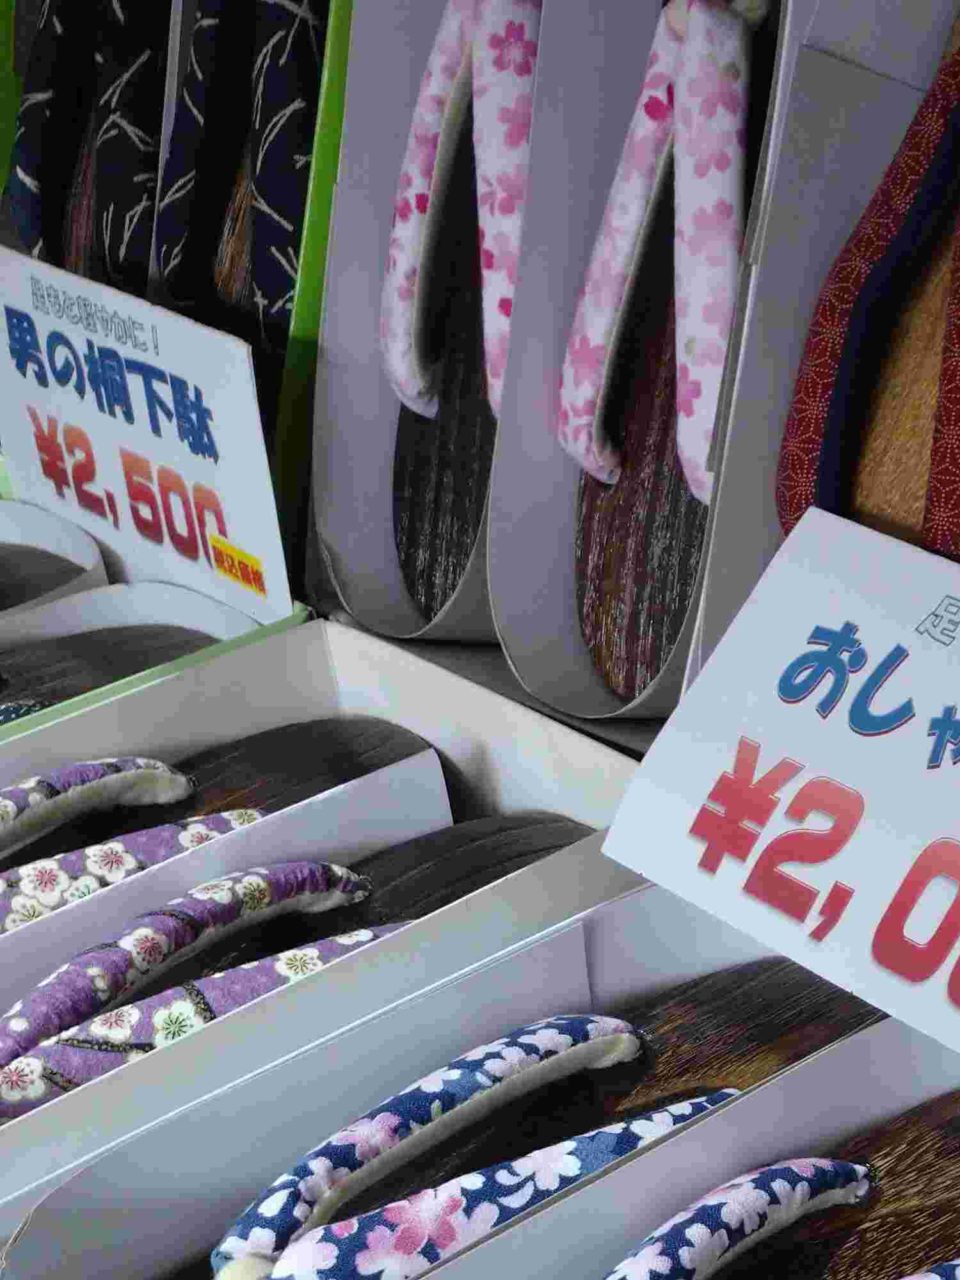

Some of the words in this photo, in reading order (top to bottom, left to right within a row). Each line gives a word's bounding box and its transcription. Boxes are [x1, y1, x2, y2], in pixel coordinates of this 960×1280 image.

[4, 305, 219, 465] 男の桐下駄
[27, 404, 228, 569] ¥2,500
